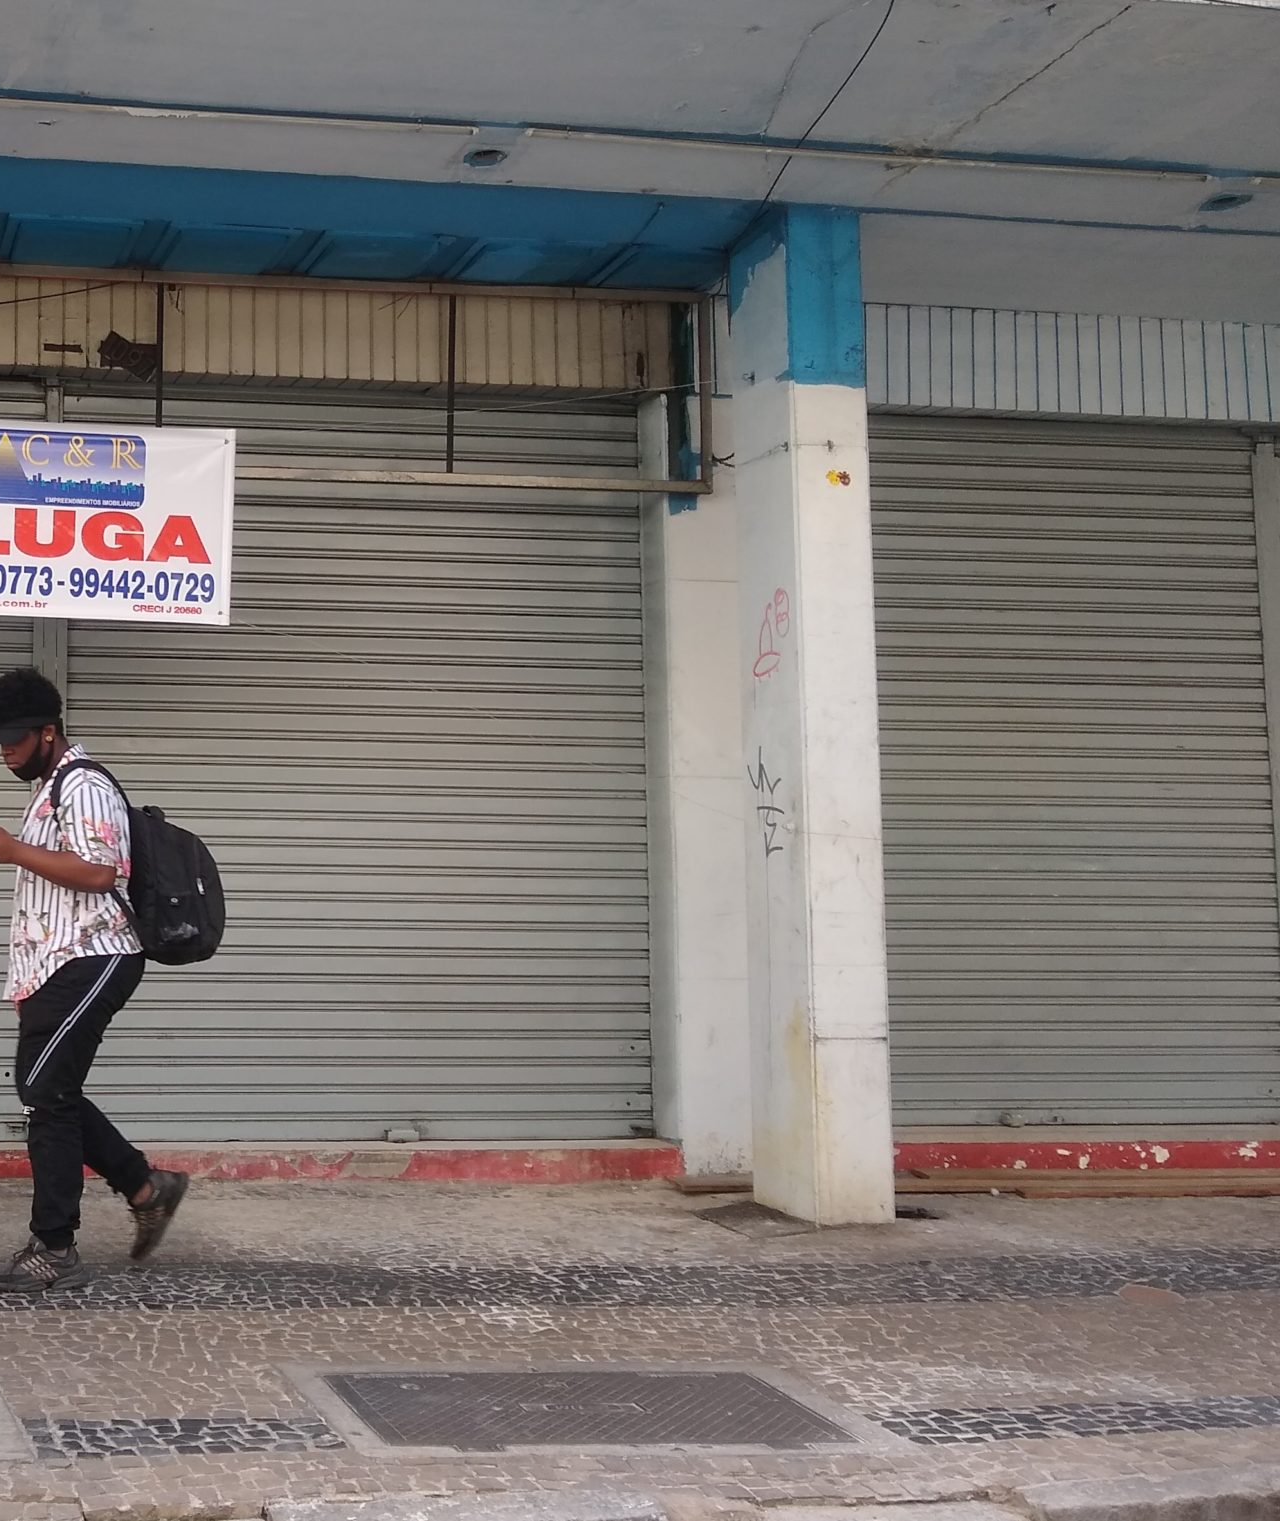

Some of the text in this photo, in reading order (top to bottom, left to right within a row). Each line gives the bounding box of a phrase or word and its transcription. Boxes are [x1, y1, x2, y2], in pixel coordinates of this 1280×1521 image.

[22, 434, 143, 470] C & R
[45, 497, 101, 505] EMPREENDIMENTOS
[70, 567, 215, 603] 99442-0729
[132, 604, 164, 613] CRECI
